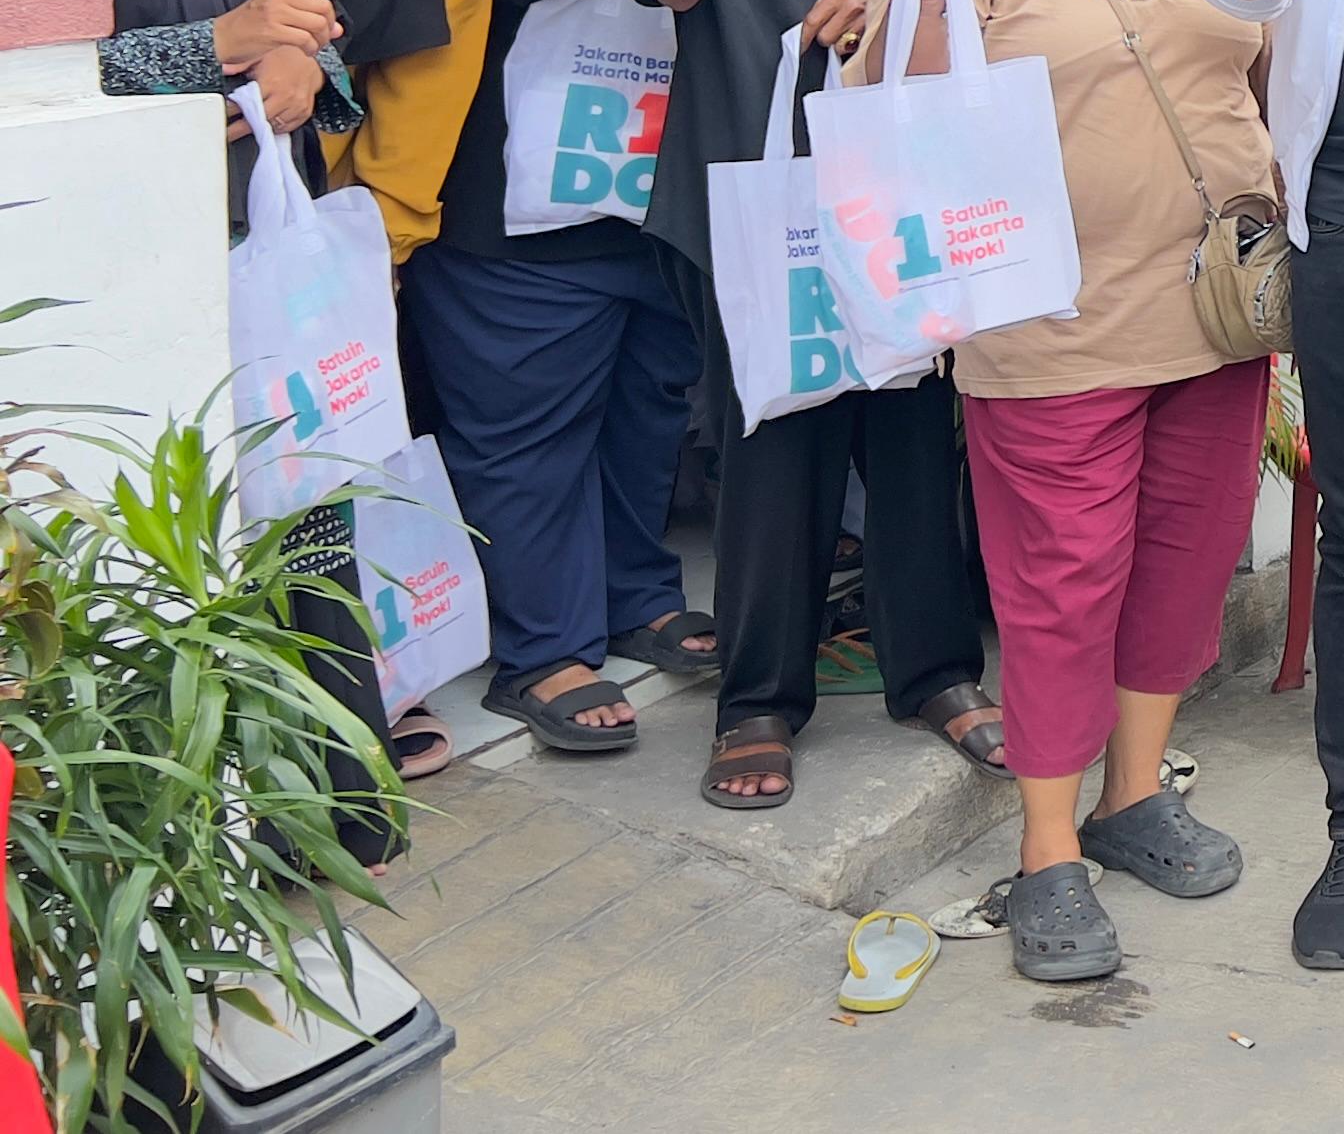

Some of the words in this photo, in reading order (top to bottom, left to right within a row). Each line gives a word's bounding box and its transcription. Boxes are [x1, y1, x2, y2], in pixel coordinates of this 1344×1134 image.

[574, 44, 642, 67] Jakarta
[571, 61, 640, 81] Jakarta
[645, 72, 670, 84] Ma
[941, 198, 1009, 225] Satuin
[787, 244, 820, 258] Jakar
[894, 213, 942, 282] 1
[945, 216, 1024, 246] Jakarta
[950, 241, 1005, 267] Nyok!
[318, 341, 366, 375] Satuin
[326, 356, 380, 397] Jakarta
[330, 381, 369, 416] Nyok!
[405, 561, 449, 591] Satuin
[411, 575, 461, 610] Jakarta
[375, 586, 407, 651] 1
[413, 596, 451, 627] Nyok!
